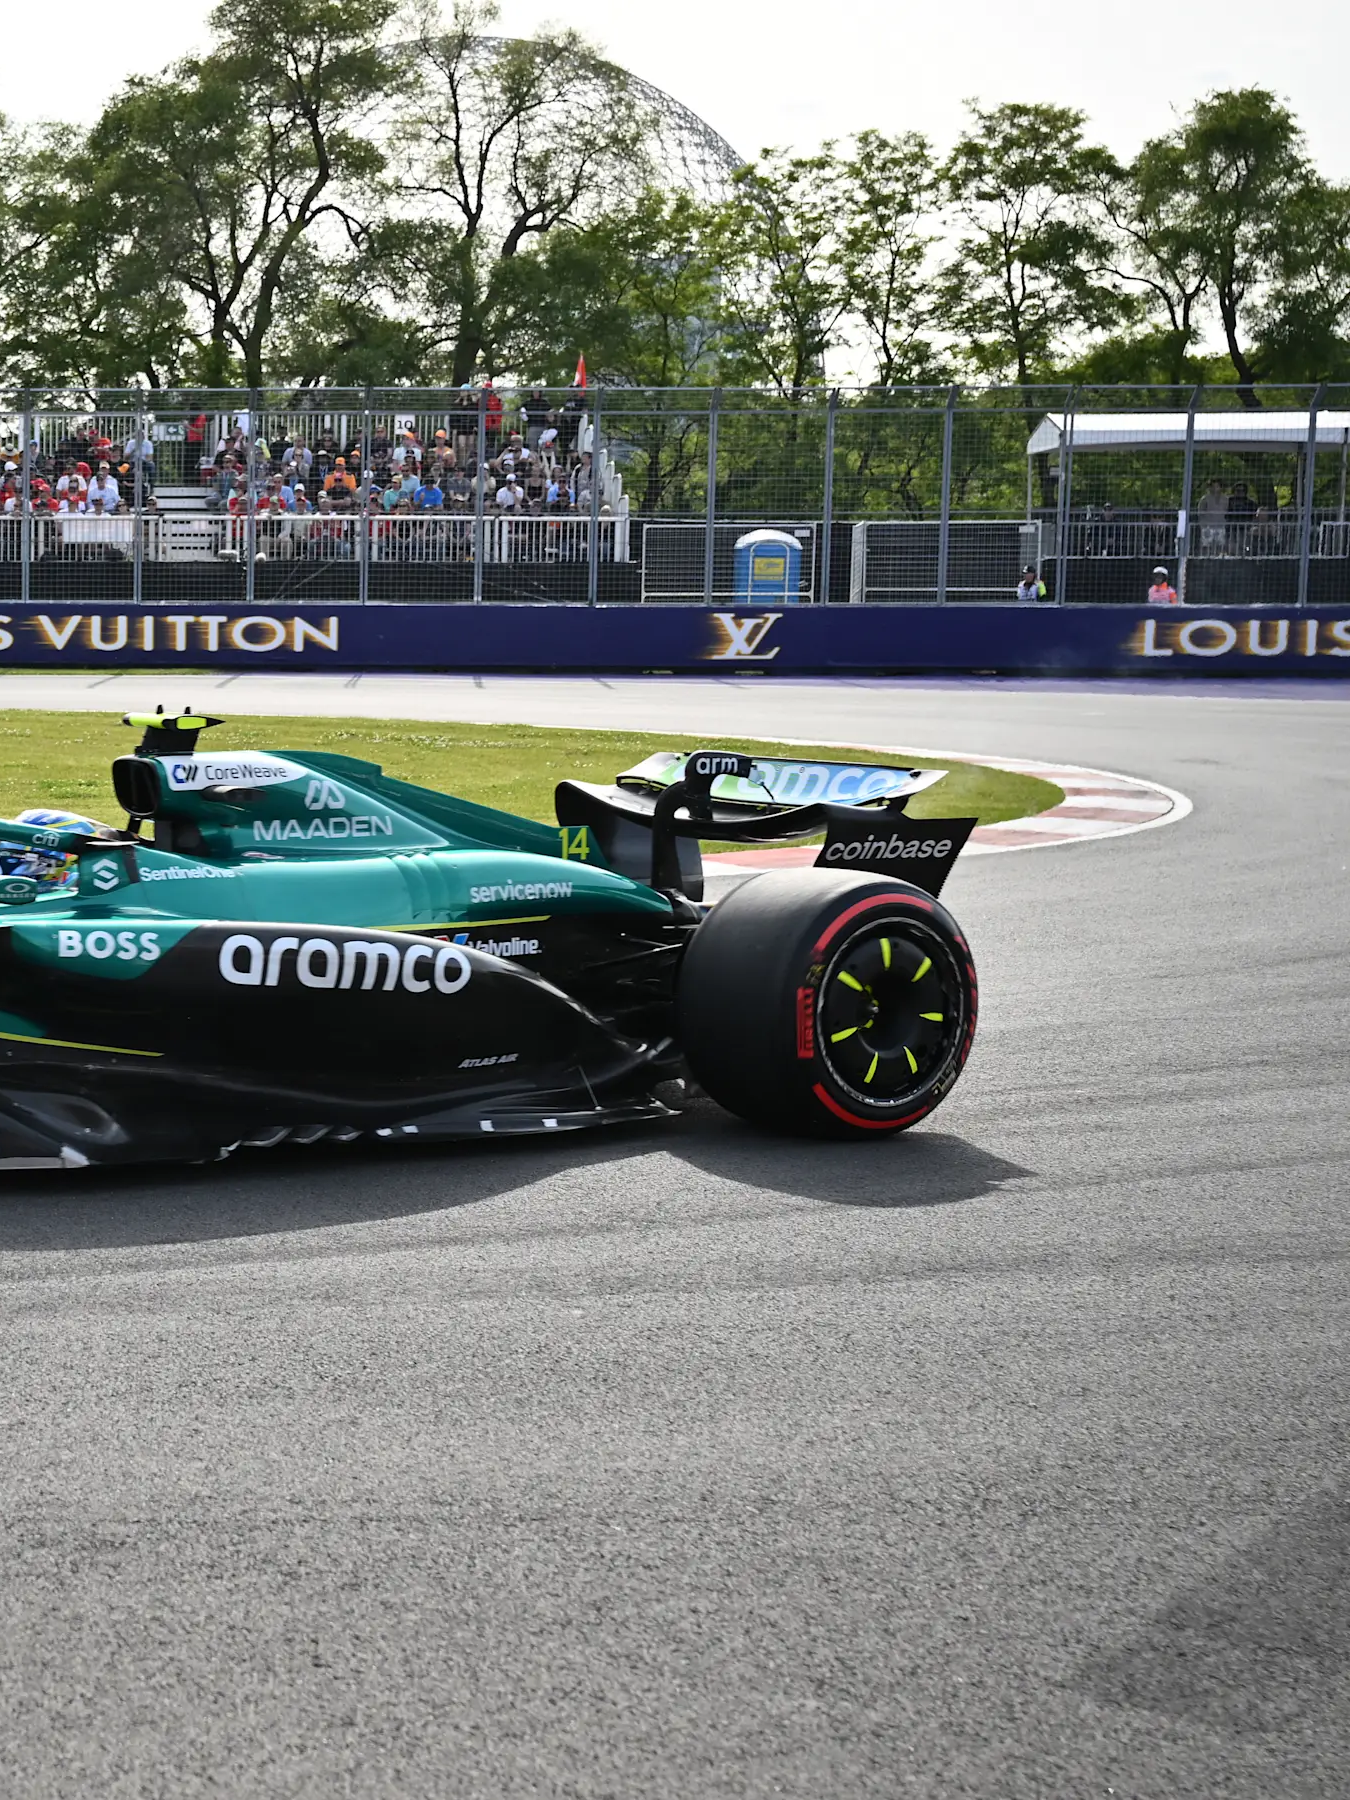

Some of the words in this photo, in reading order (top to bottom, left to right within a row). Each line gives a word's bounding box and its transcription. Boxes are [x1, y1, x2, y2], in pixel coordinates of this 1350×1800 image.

[397, 420, 413, 430] 10
[37, 614, 339, 652] VUITTON
[204, 764, 288, 780] CoreWeave
[695, 757, 738, 774] arm
[253, 816, 393, 841] MAADEN
[558, 827, 590, 860] 14
[825, 834, 953, 861] coinbase
[139, 866, 236, 881] SentinelOne
[470, 879, 573, 903] servicenow
[58, 930, 161, 961] BOSS
[219, 934, 472, 994] aramco
